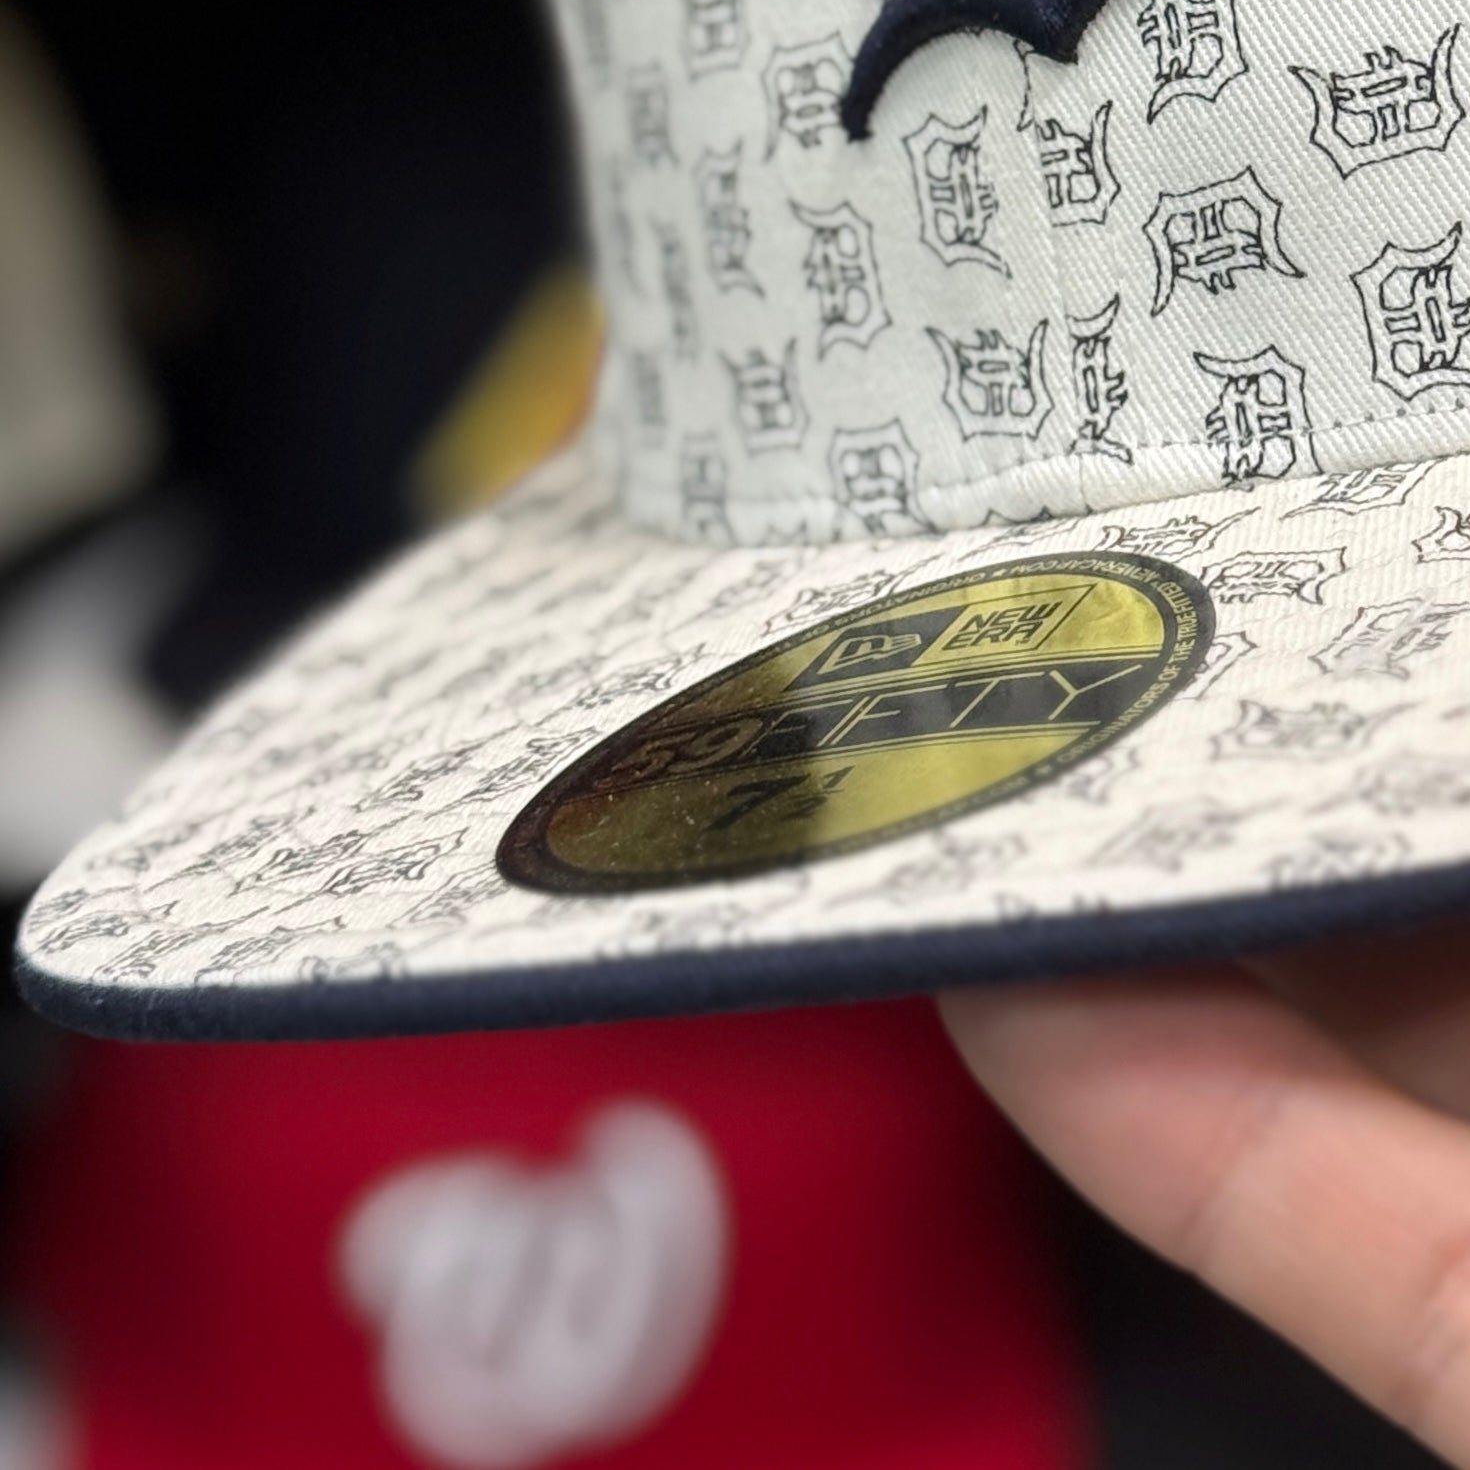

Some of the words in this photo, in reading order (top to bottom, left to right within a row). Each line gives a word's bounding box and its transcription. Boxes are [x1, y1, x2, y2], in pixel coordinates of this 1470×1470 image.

[965, 601, 1063, 628] NEW
[1176, 611, 1198, 640] TRUE
[942, 621, 1043, 650] ERA
[1169, 639, 1195, 664] THE
[1157, 662, 1182, 682] OF
[1056, 681, 1170, 763] ORIGINATORS
[702, 774, 810, 832] 7
